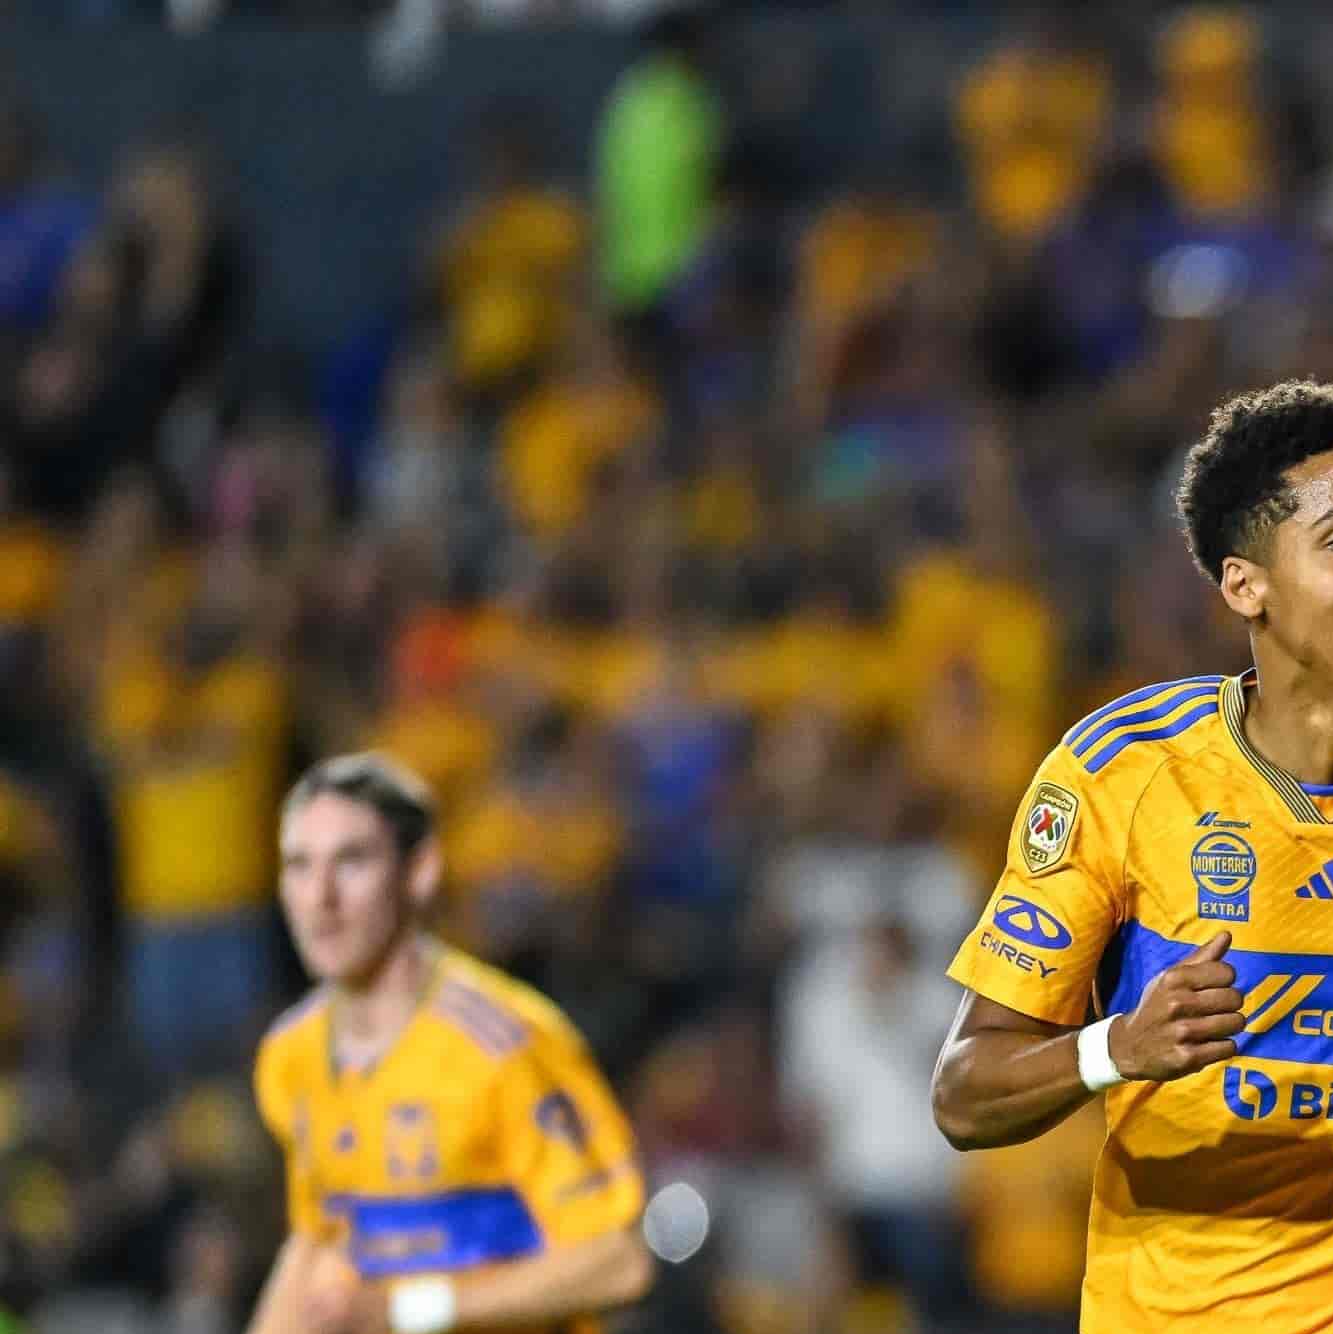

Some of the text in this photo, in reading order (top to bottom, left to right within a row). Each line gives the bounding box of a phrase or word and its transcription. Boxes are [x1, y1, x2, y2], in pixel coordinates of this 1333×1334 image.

[1191, 855, 1254, 874] MONTERREY
[1200, 902, 1246, 917] EXTRA
[980, 931, 1059, 979] CHIREY
